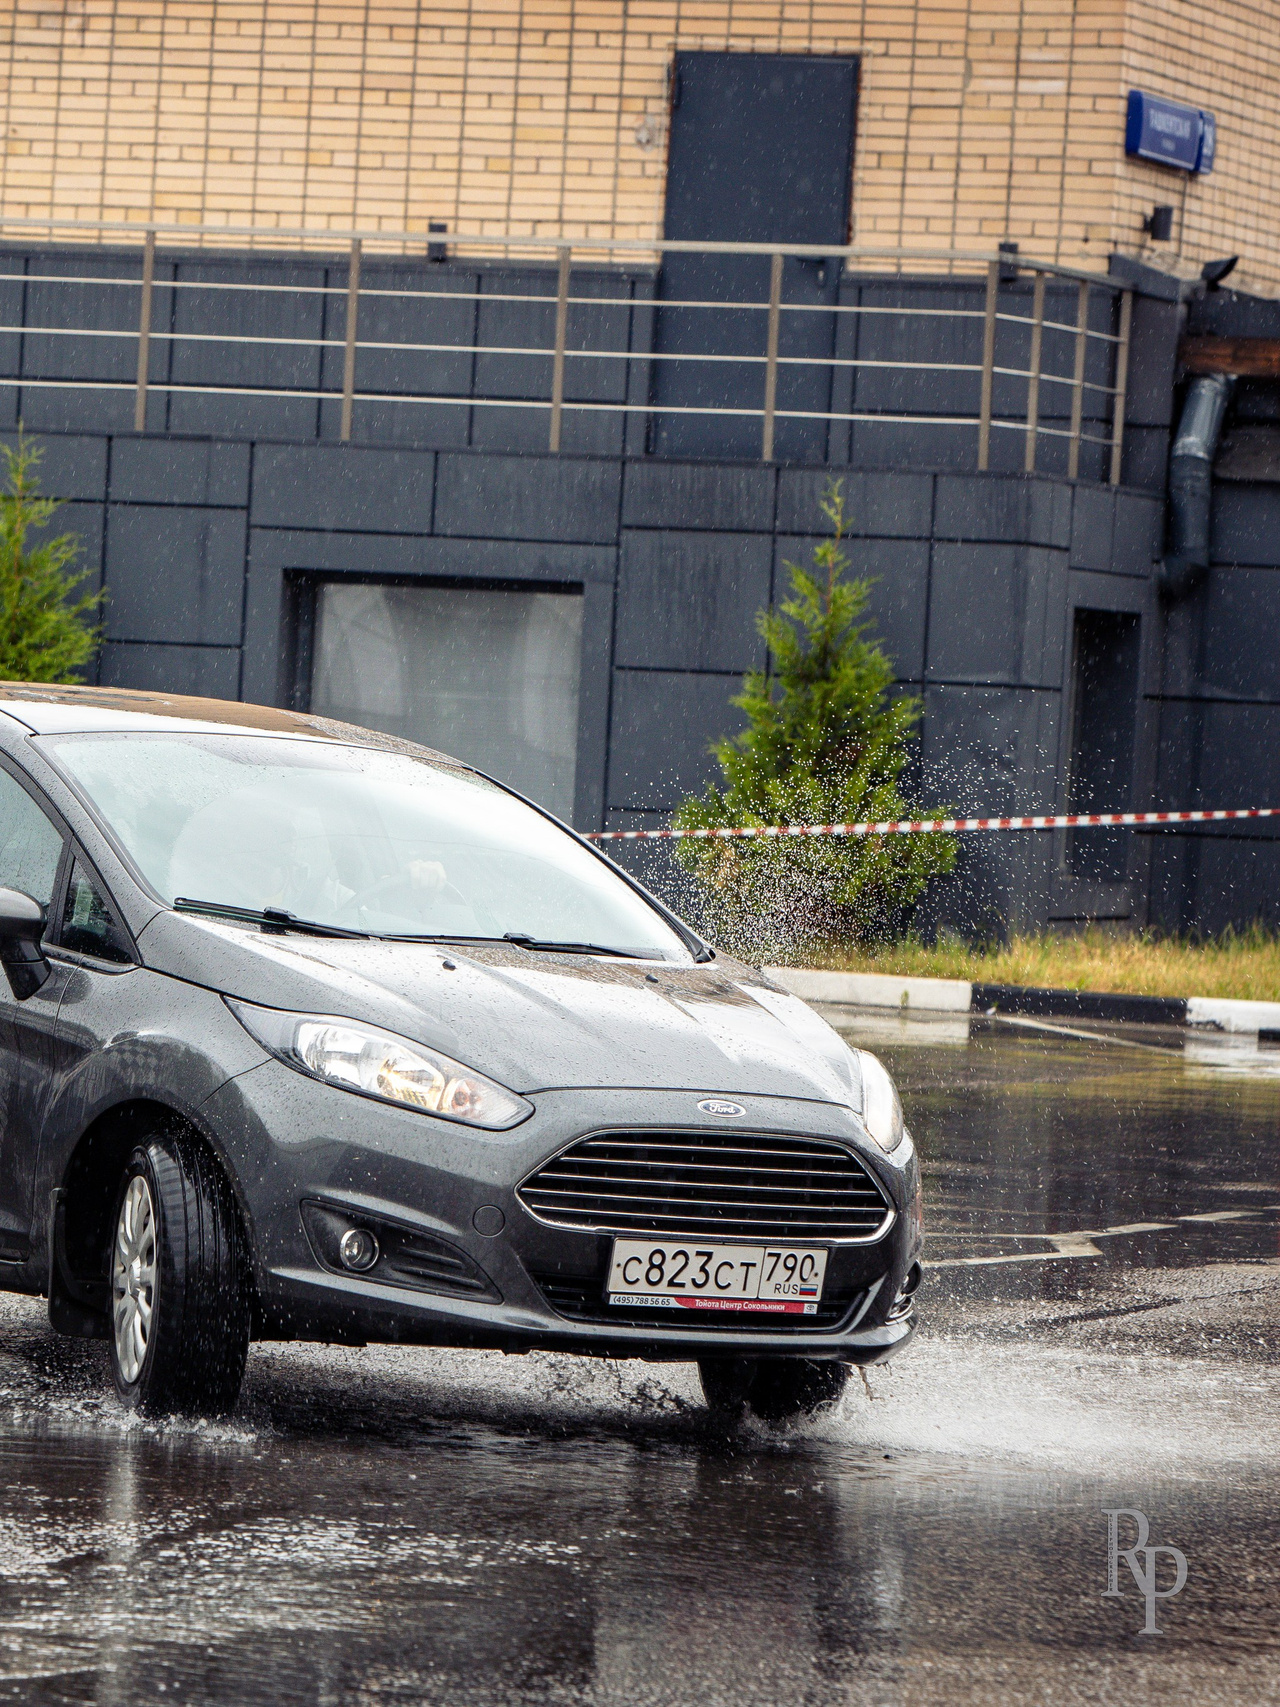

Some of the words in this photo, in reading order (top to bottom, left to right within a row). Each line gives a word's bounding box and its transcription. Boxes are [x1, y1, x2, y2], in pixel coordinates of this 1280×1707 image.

[709, 1102, 736, 1113] Ford
[766, 1252, 816, 1283] 790
[774, 1283, 799, 1295] RUS
[613, 1295, 634, 1304] (495)
[635, 1297, 649, 1305] 788
[650, 1297, 660, 1305] 56
[661, 1298, 671, 1306] 65
[695, 1299, 719, 1308] Тойота
[720, 1301, 742, 1310] Центр
[743, 1302, 785, 1311] Сокольники
